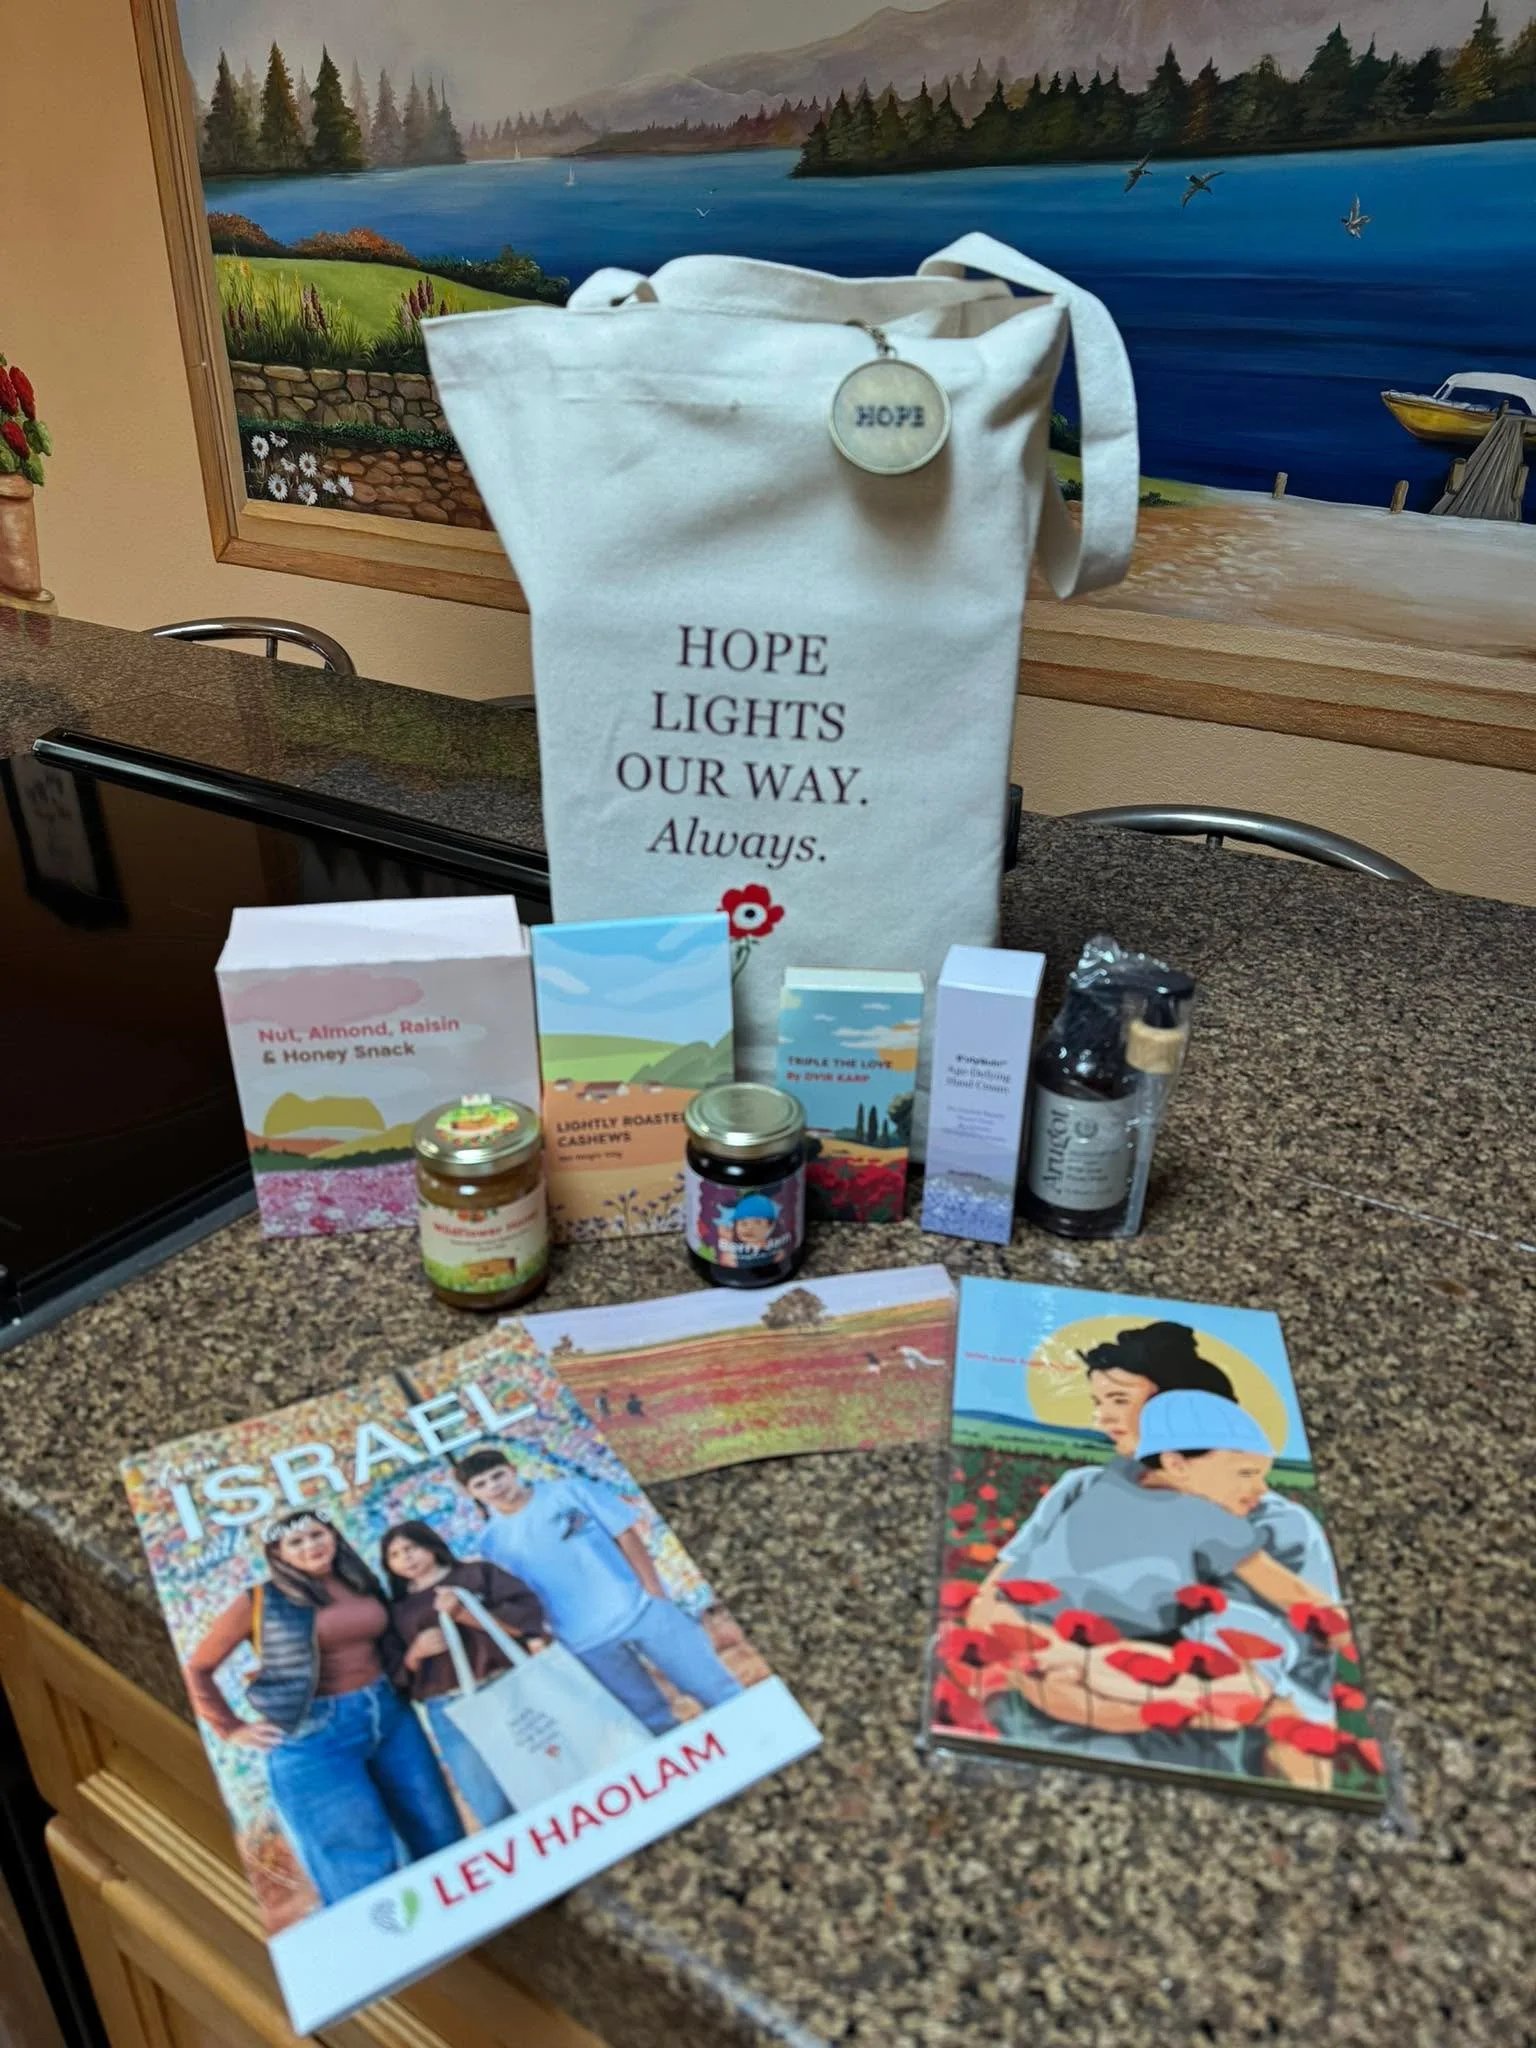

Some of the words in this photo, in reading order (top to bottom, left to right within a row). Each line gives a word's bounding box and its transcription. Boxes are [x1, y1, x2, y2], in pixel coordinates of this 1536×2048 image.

[855, 405, 925, 428] HOPE
[677, 624, 828, 677] HOPE
[652, 690, 845, 743] LIGHTS
[617, 752, 729, 798] OUR
[744, 761, 868, 806] WAY.
[646, 816, 826, 870] Always.
[258, 1028, 302, 1043] Nut,
[309, 1022, 394, 1040] Almond,
[400, 1016, 460, 1034] Raisin
[263, 1050, 276, 1064] &
[283, 1047, 348, 1064] Honey
[355, 1041, 416, 1059] Snack
[788, 1056, 828, 1067] TRIPLE
[833, 1058, 857, 1068] THE
[861, 1060, 893, 1070] LOVE
[556, 1117, 617, 1132] LIGHTLY
[558, 1131, 632, 1147] CASHEWS
[170, 1383, 538, 1542] ISRAEL
[432, 1838, 517, 1908] LEV
[528, 1730, 728, 1857] HAOLAM
